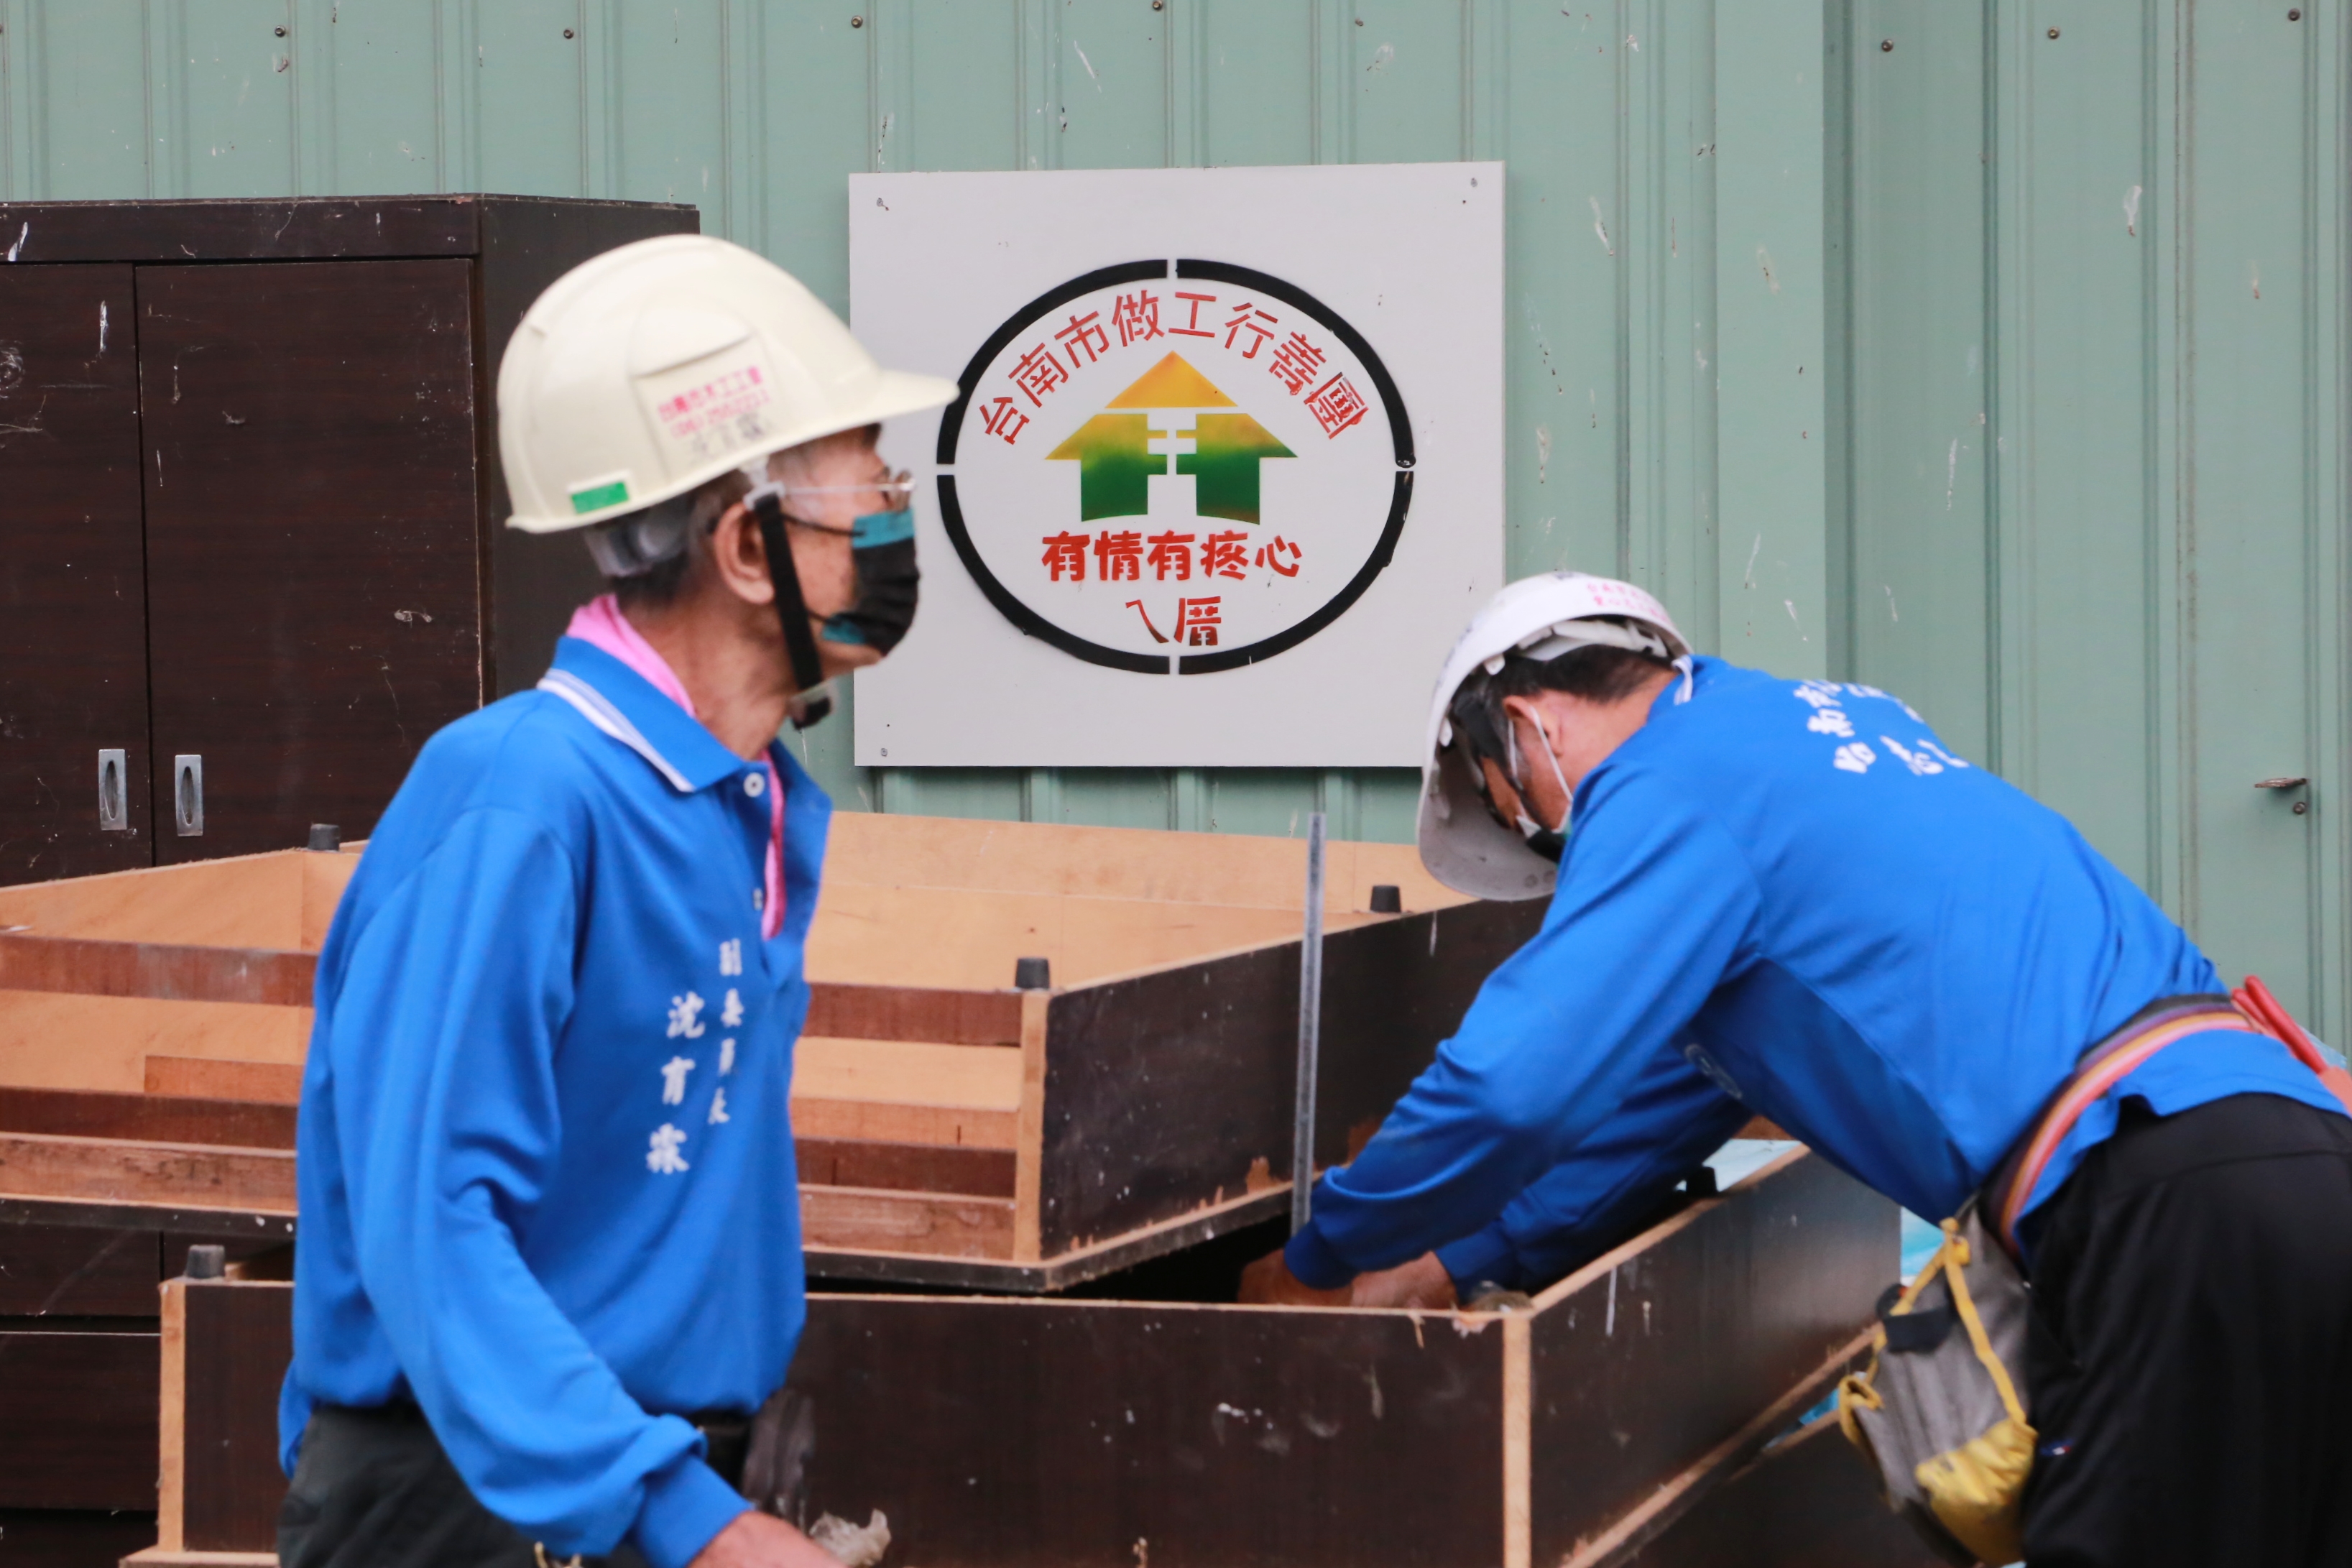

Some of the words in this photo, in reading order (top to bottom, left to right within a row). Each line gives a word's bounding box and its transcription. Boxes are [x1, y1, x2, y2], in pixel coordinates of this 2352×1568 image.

[1041, 530, 1302, 581] 有情有疼心
